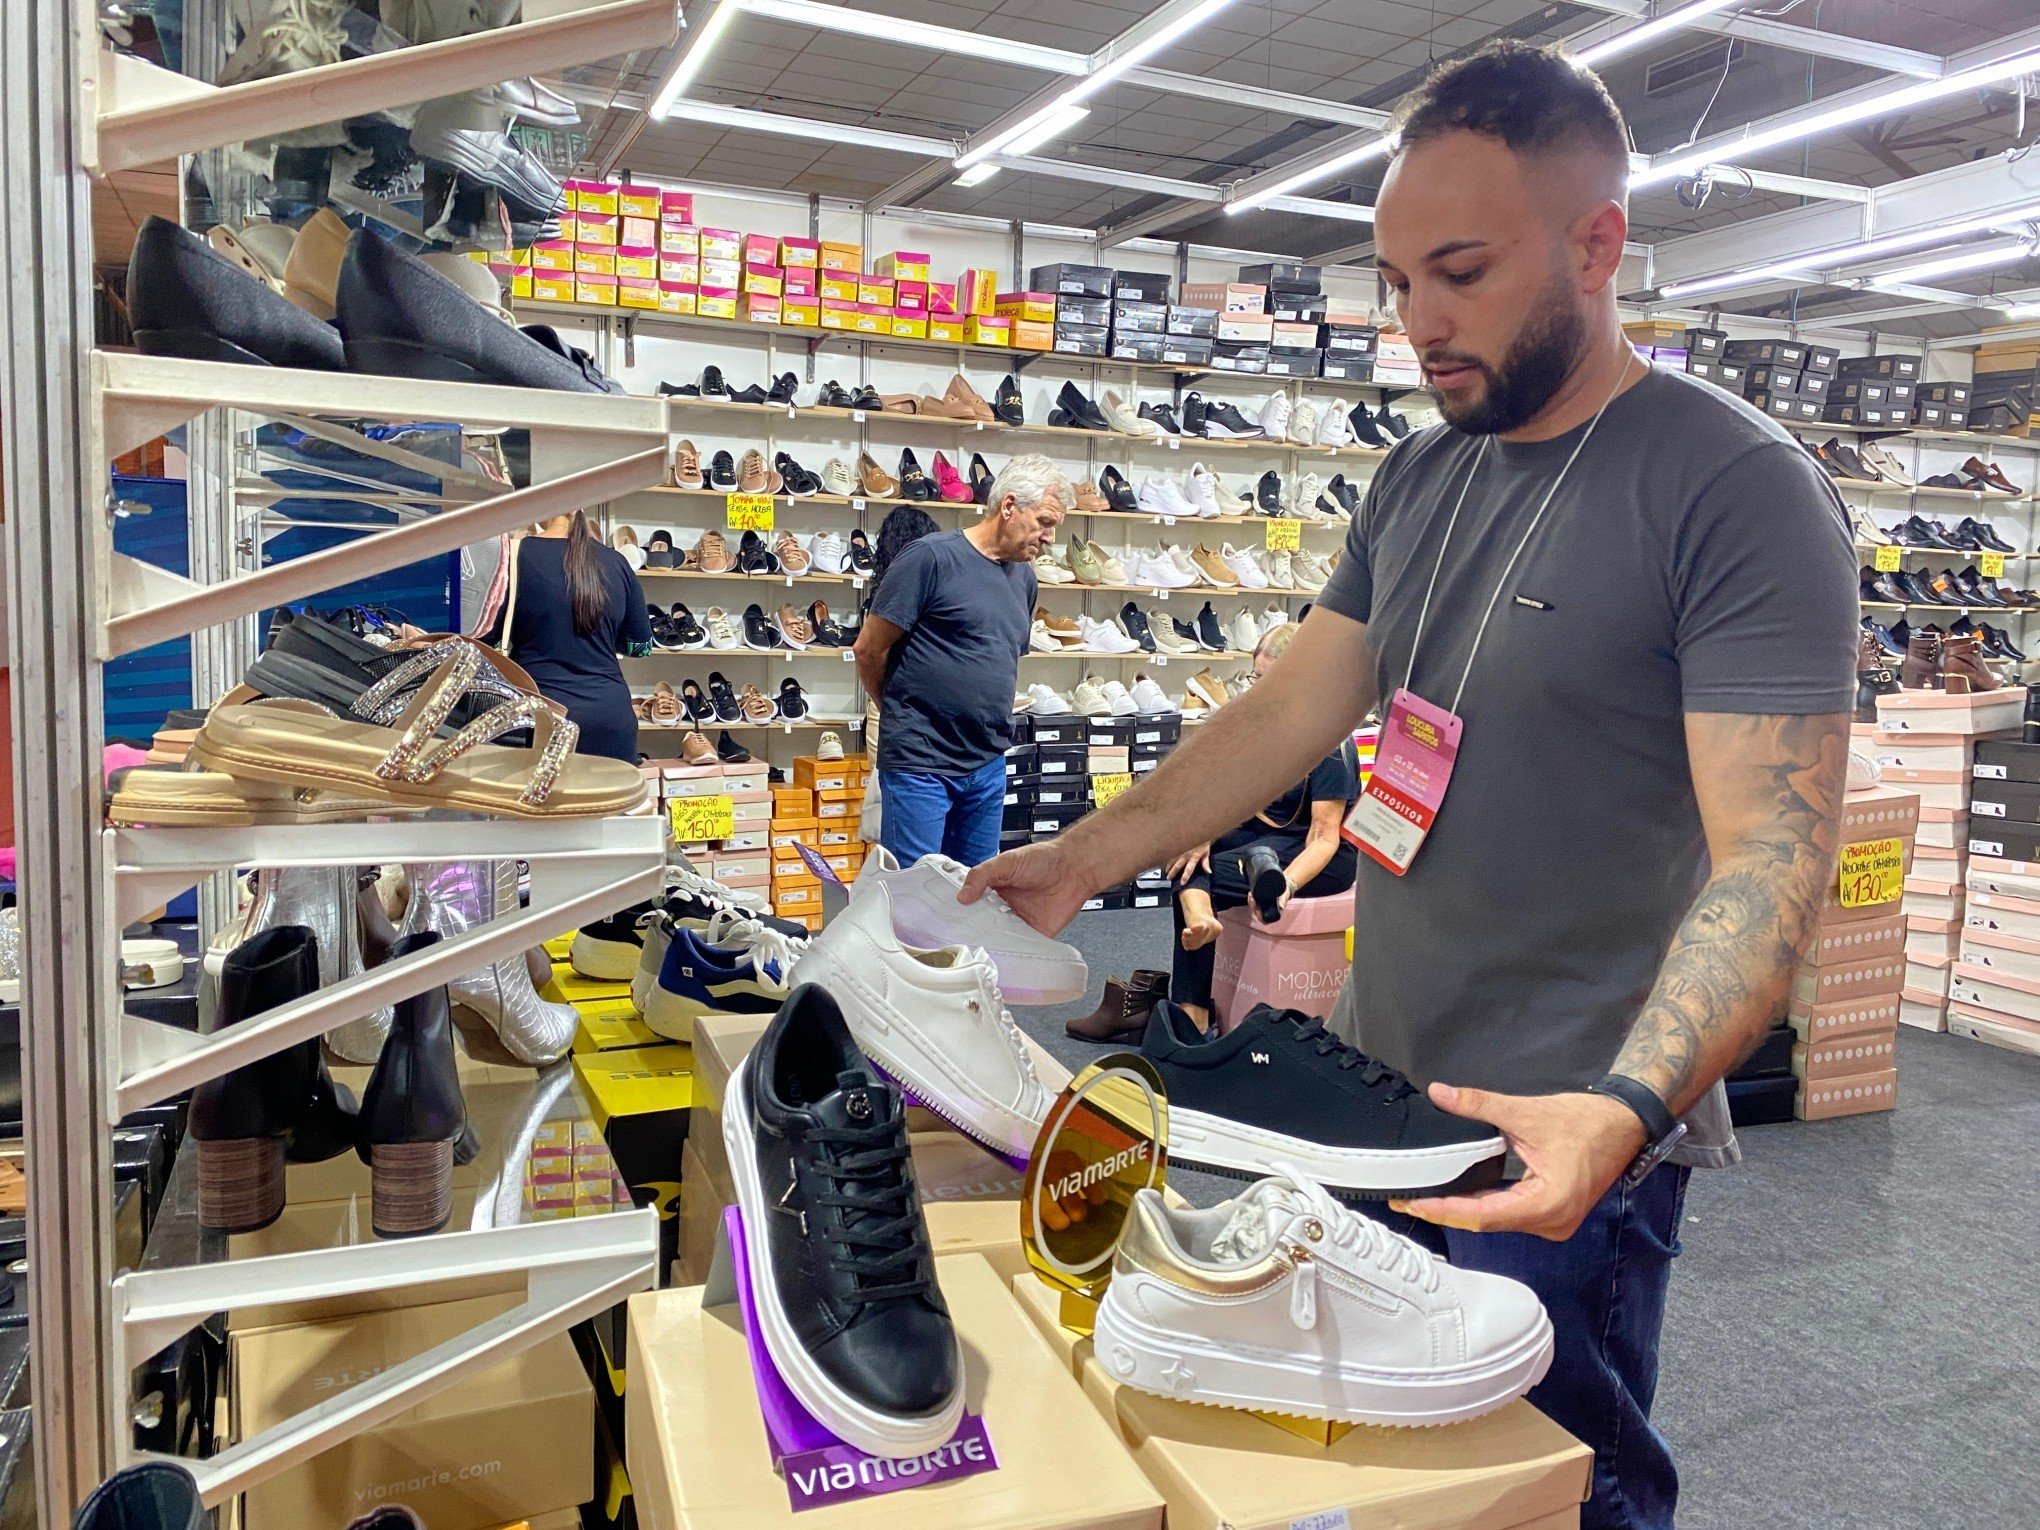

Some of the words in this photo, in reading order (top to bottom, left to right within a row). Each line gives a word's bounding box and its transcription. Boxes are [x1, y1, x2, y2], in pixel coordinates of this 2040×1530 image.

[667, 204, 689, 212] moleca
[903, 292, 923, 300] moleca
[981, 278, 990, 308] moleca
[995, 302, 1020, 317] moleca
[1372, 786, 1424, 824] EXPOSITOR
[688, 819, 715, 839] 150
[1845, 841, 1891, 859] PROMOÇÃO
[1853, 873, 1882, 904] 130
[1215, 952, 1241, 977] DARE
[1250, 1051, 1270, 1065] VM
[352, 1458, 502, 1502] viamarte.com
